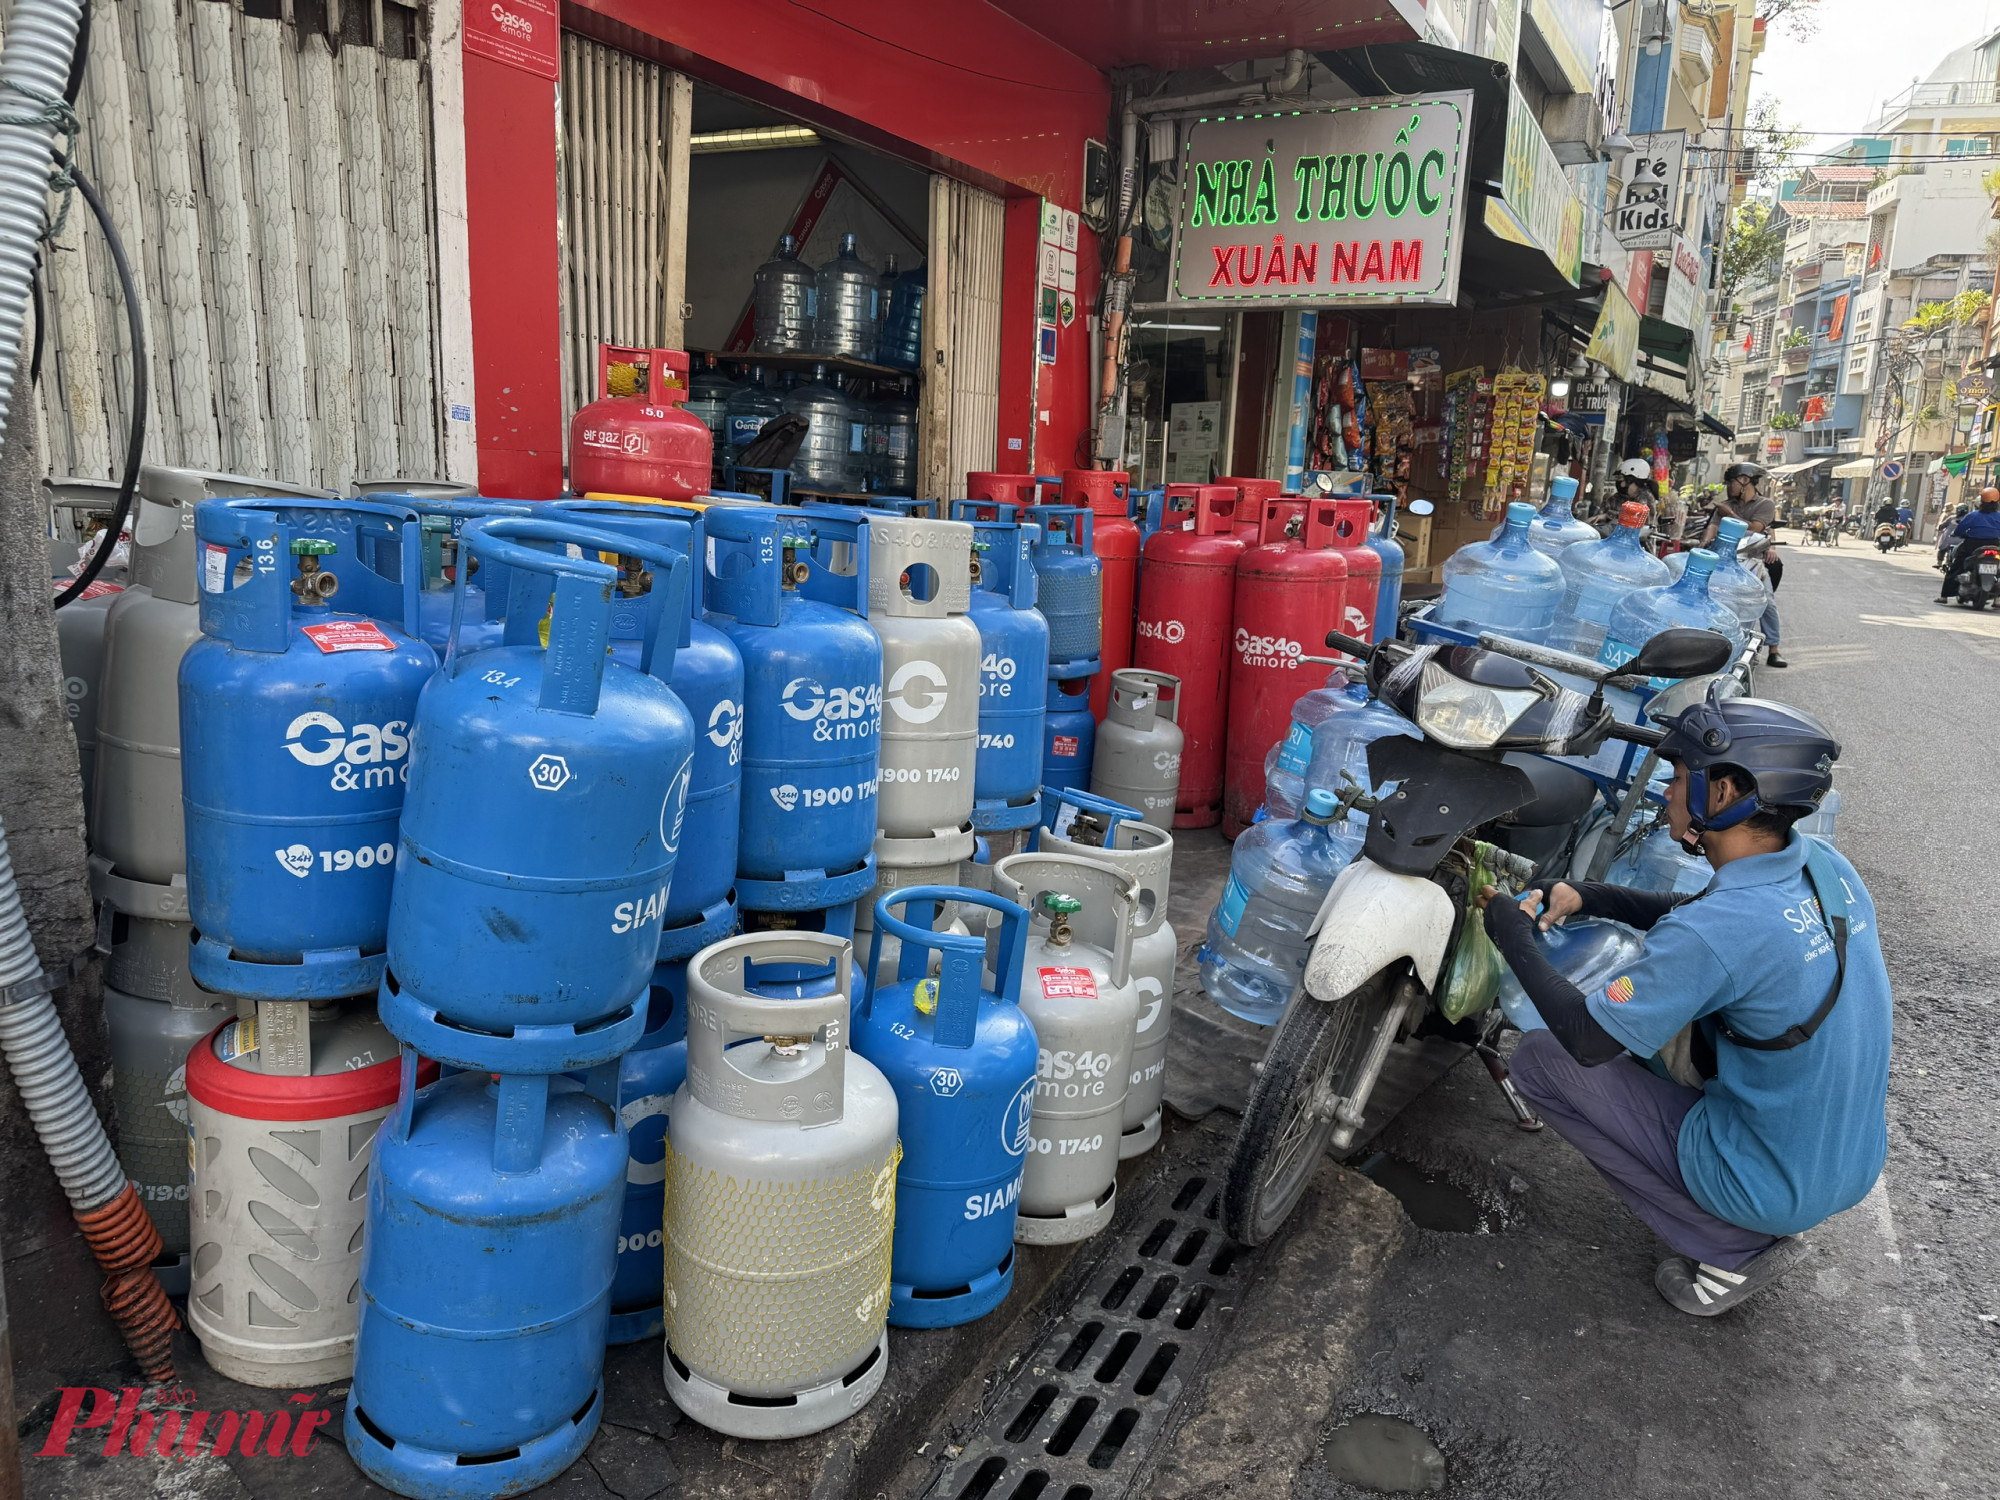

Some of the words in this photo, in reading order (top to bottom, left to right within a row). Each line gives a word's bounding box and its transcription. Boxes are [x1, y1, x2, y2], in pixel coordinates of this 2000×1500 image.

[1191, 139, 1279, 227] NHÀ
[1295, 114, 1446, 221] THUỐC
[1619, 208, 1669, 230] Kids
[1209, 234, 1319, 287] XUÂN
[1331, 239, 1424, 285] NAM
[598, 430, 619, 444] gaz
[453, 518, 463, 536] 3.4
[870, 527, 890, 545] AS
[256, 538, 275, 577] 13.6
[761, 535, 774, 564] 13.5
[1021, 540, 1029, 561] 13.5
[1137, 619, 1186, 645] as4.0
[1243, 652, 1298, 670] &more
[481, 669, 522, 690] 13.4
[978, 683, 1012, 697] ore
[537, 763, 560, 784] 30
[926, 766, 960, 783] 1740
[781, 791, 798, 800] 24H
[803, 786, 854, 808] 1900
[319, 843, 394, 873] 1900
[826, 1019, 840, 1052] 13.5
[890, 1022, 915, 1041] 13.2
[345, 1051, 376, 1071] 12.7
[1036, 1048, 1112, 1079] as4.0
[937, 1072, 958, 1088] 30
[1036, 1080, 1105, 1099] more
[1059, 1134, 1103, 1155] 1740
[617, 1229, 664, 1255] 900
